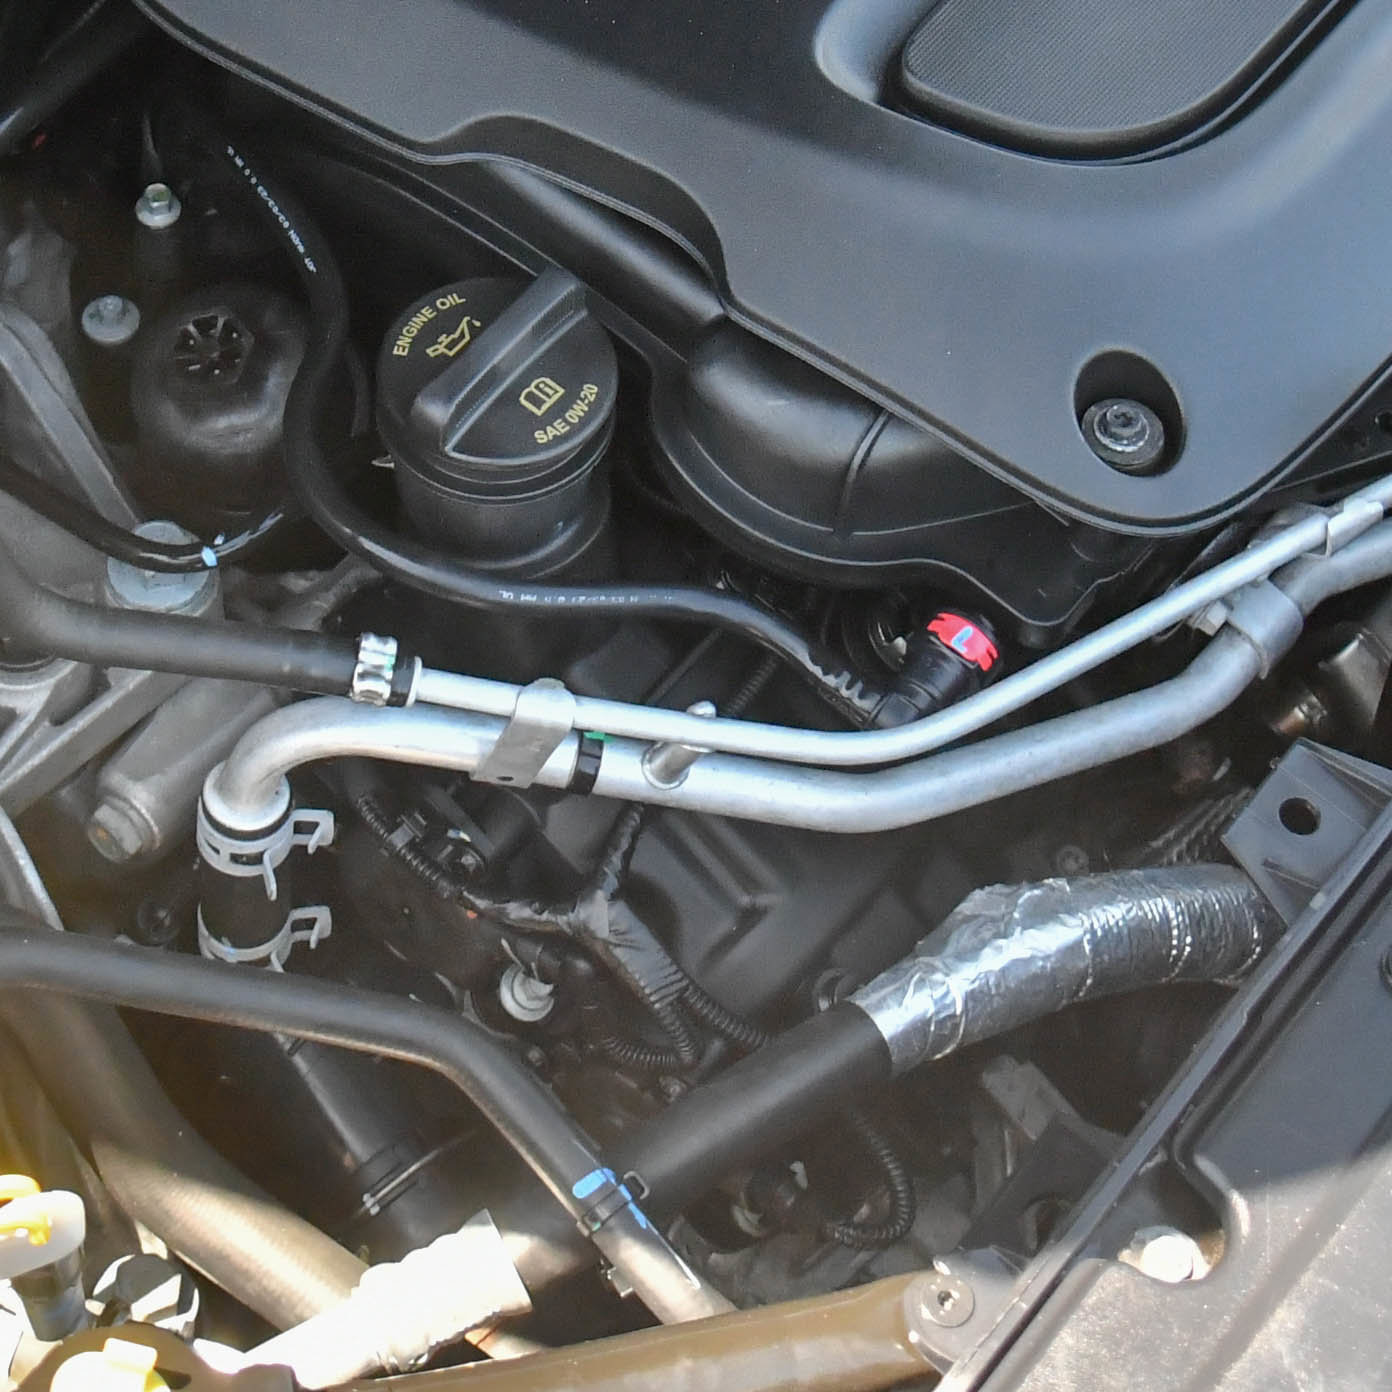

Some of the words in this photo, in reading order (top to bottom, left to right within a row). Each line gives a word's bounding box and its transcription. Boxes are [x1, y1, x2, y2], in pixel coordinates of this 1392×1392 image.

[393, 306, 437, 357] ENGINE
[436, 293, 466, 310] OIL
[533, 419, 570, 444] SAE
[565, 383, 599, 423] 0W-20
